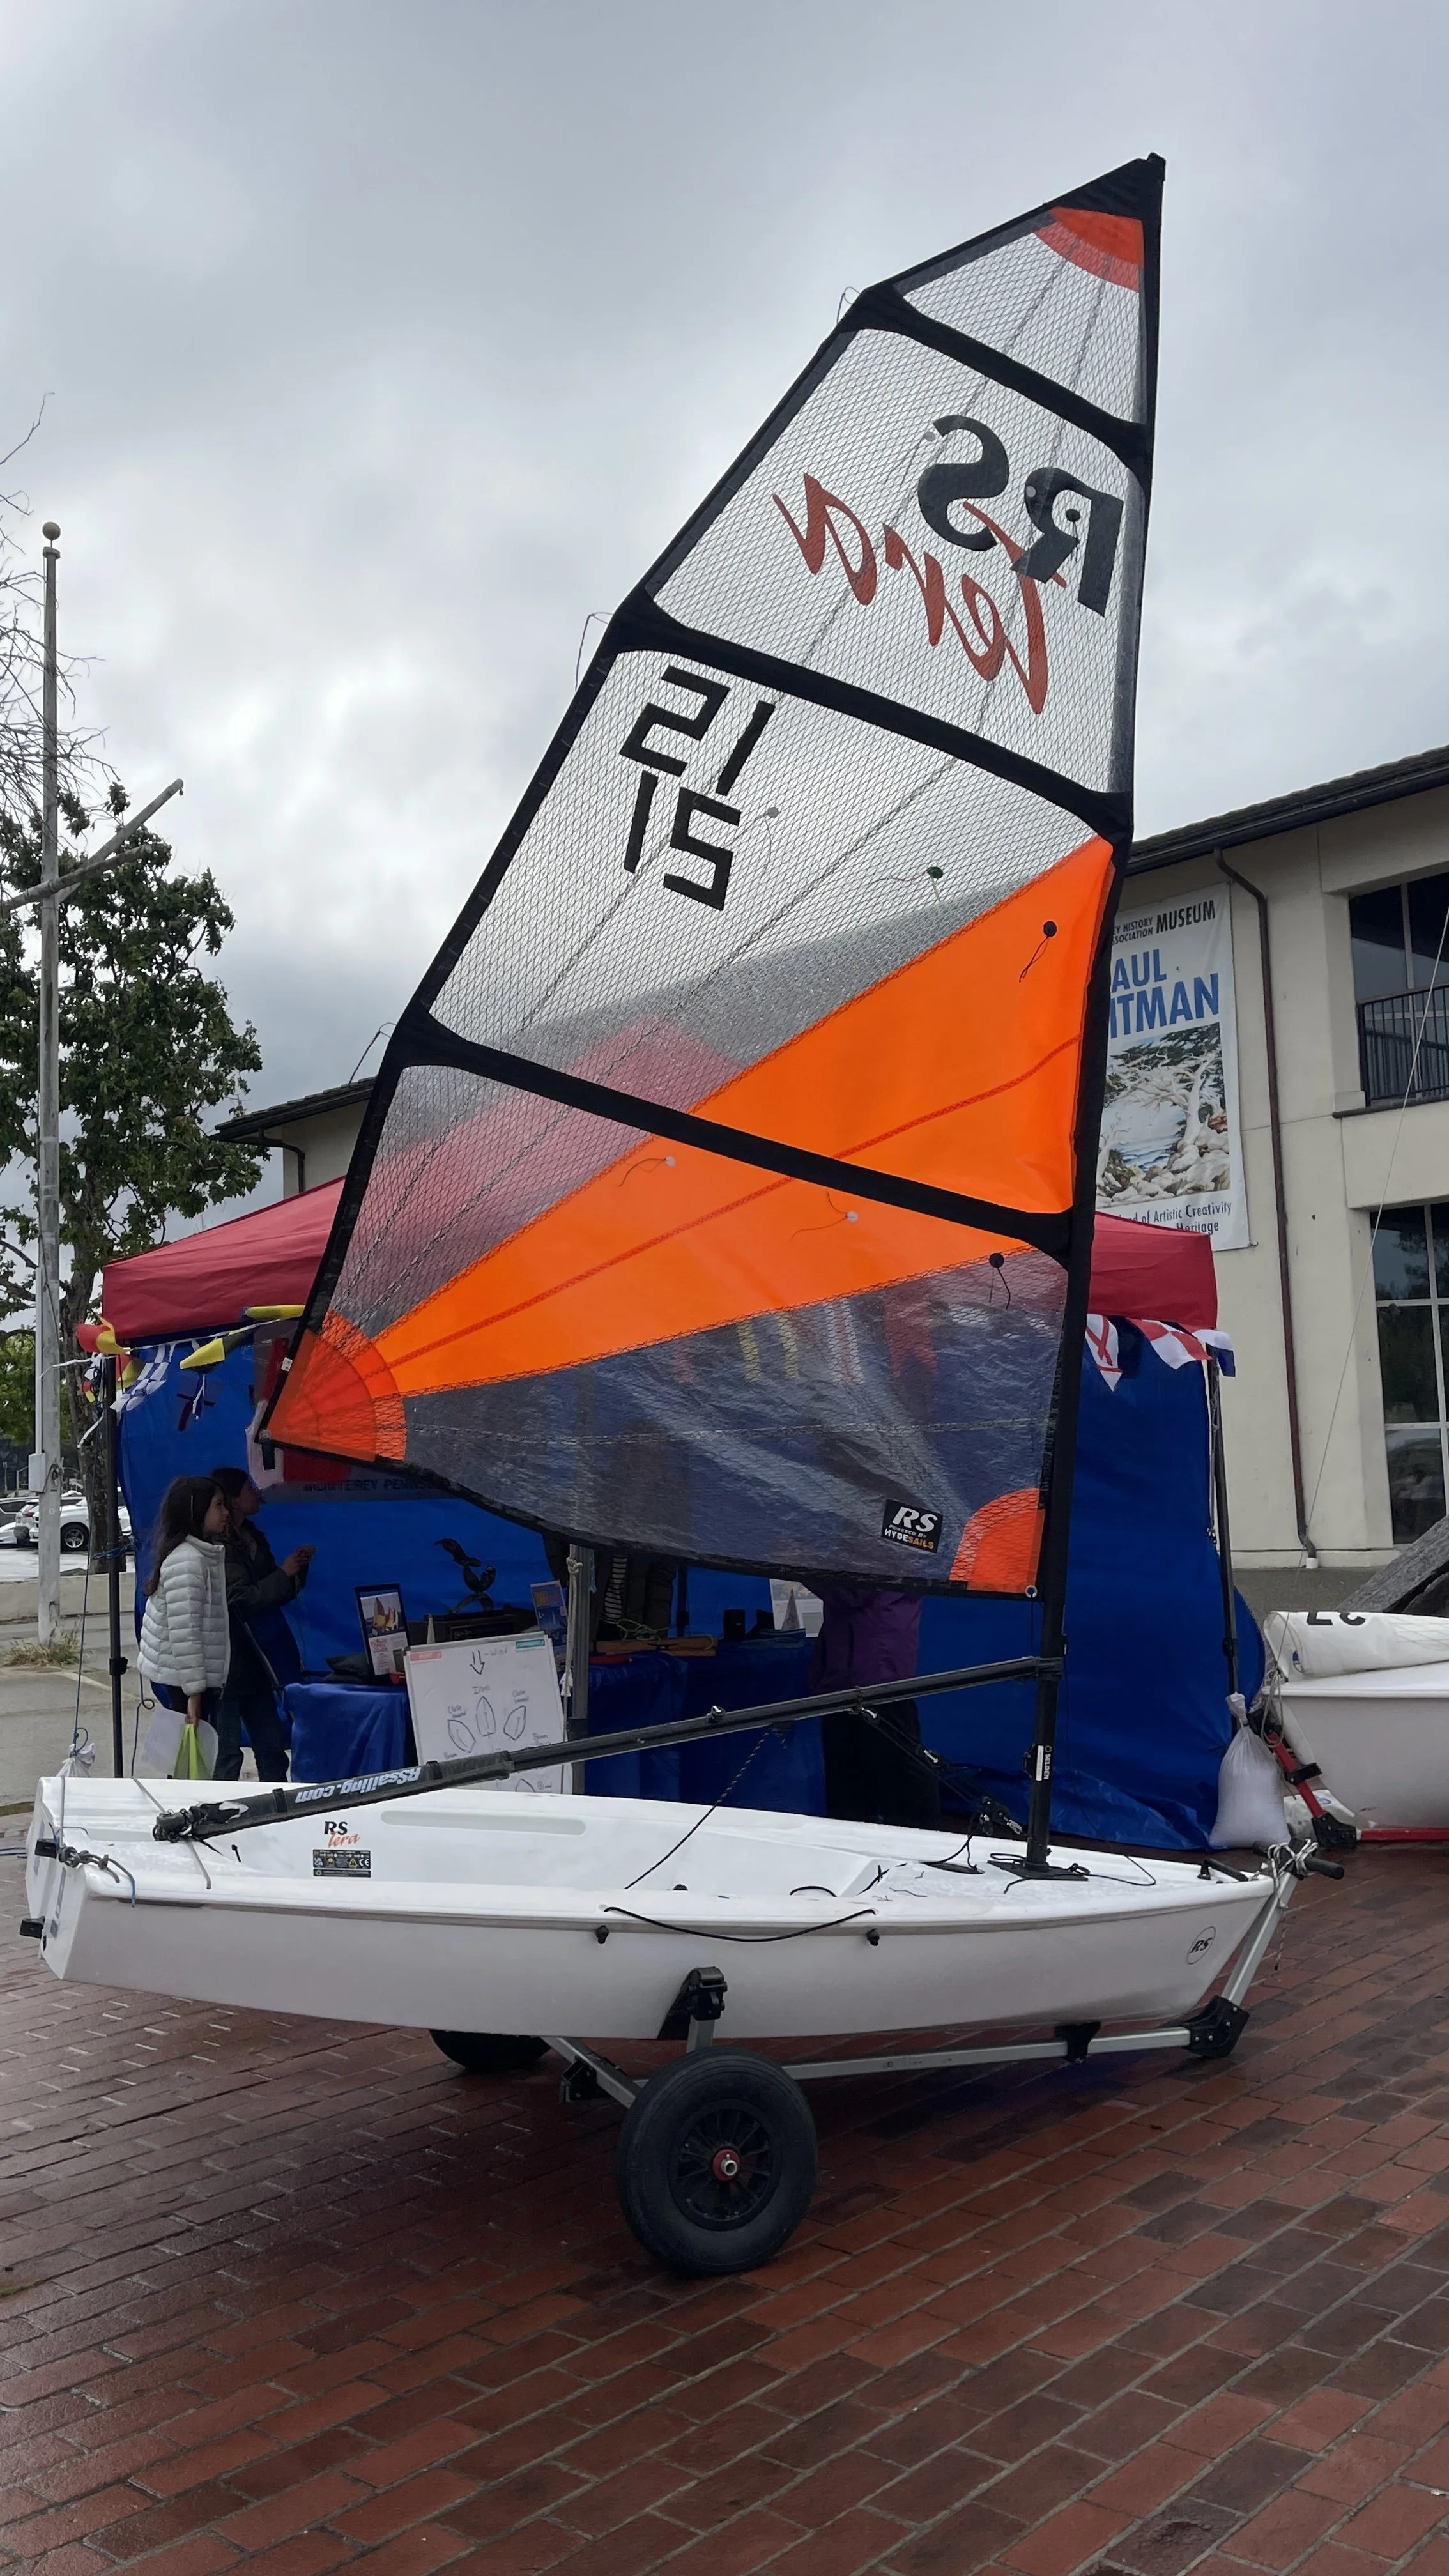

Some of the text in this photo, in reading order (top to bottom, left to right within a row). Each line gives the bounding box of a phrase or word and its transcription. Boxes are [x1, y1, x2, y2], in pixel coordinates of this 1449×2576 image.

[1123, 916, 1153, 933] HISTORY
[1156, 900, 1216, 934] MUSEUM
[1154, 1208, 1183, 1223] Artistic
[1185, 1201, 1232, 1218] Creativity
[892, 1506, 938, 1532] RS
[295, 1766, 422, 1804] RSsailing.com
[324, 1821, 348, 1836] RS
[1190, 1936, 1213, 1954] RS
